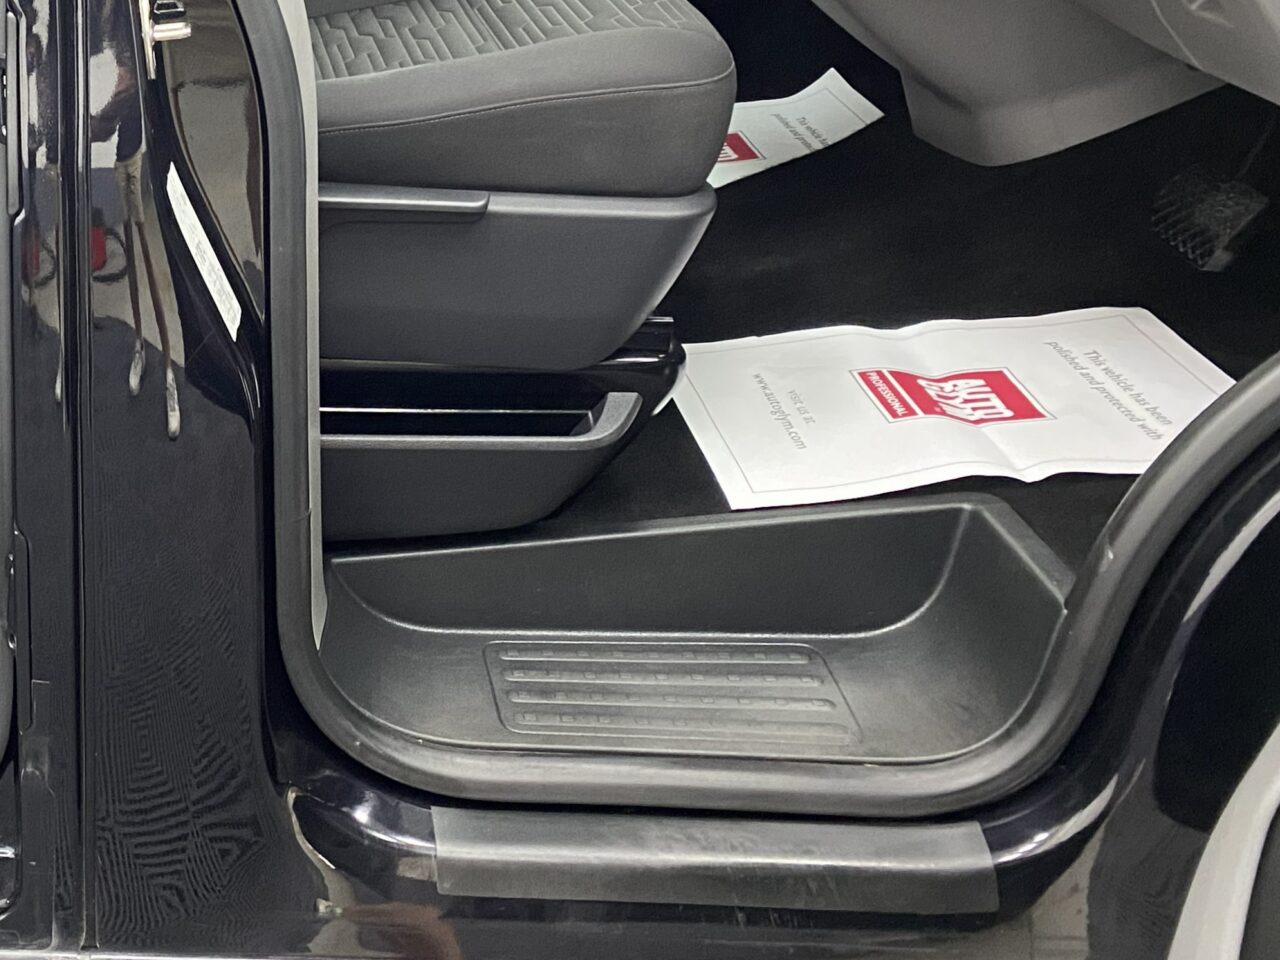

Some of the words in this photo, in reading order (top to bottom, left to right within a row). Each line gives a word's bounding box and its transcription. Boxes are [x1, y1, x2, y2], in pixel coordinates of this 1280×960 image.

[1042, 341, 1090, 371] polished
[866, 371, 910, 416] PROFESSIONAL
[1079, 371, 1105, 386] and
[1083, 349, 1106, 366] This
[1101, 366, 1135, 392] vehicle
[1129, 392, 1151, 406] has
[1145, 406, 1173, 425] been
[752, 372, 807, 450] www.autoglym.com
[948, 379, 1015, 419] AUTO
[1089, 386, 1147, 423] protected
[1137, 423, 1164, 440] with
